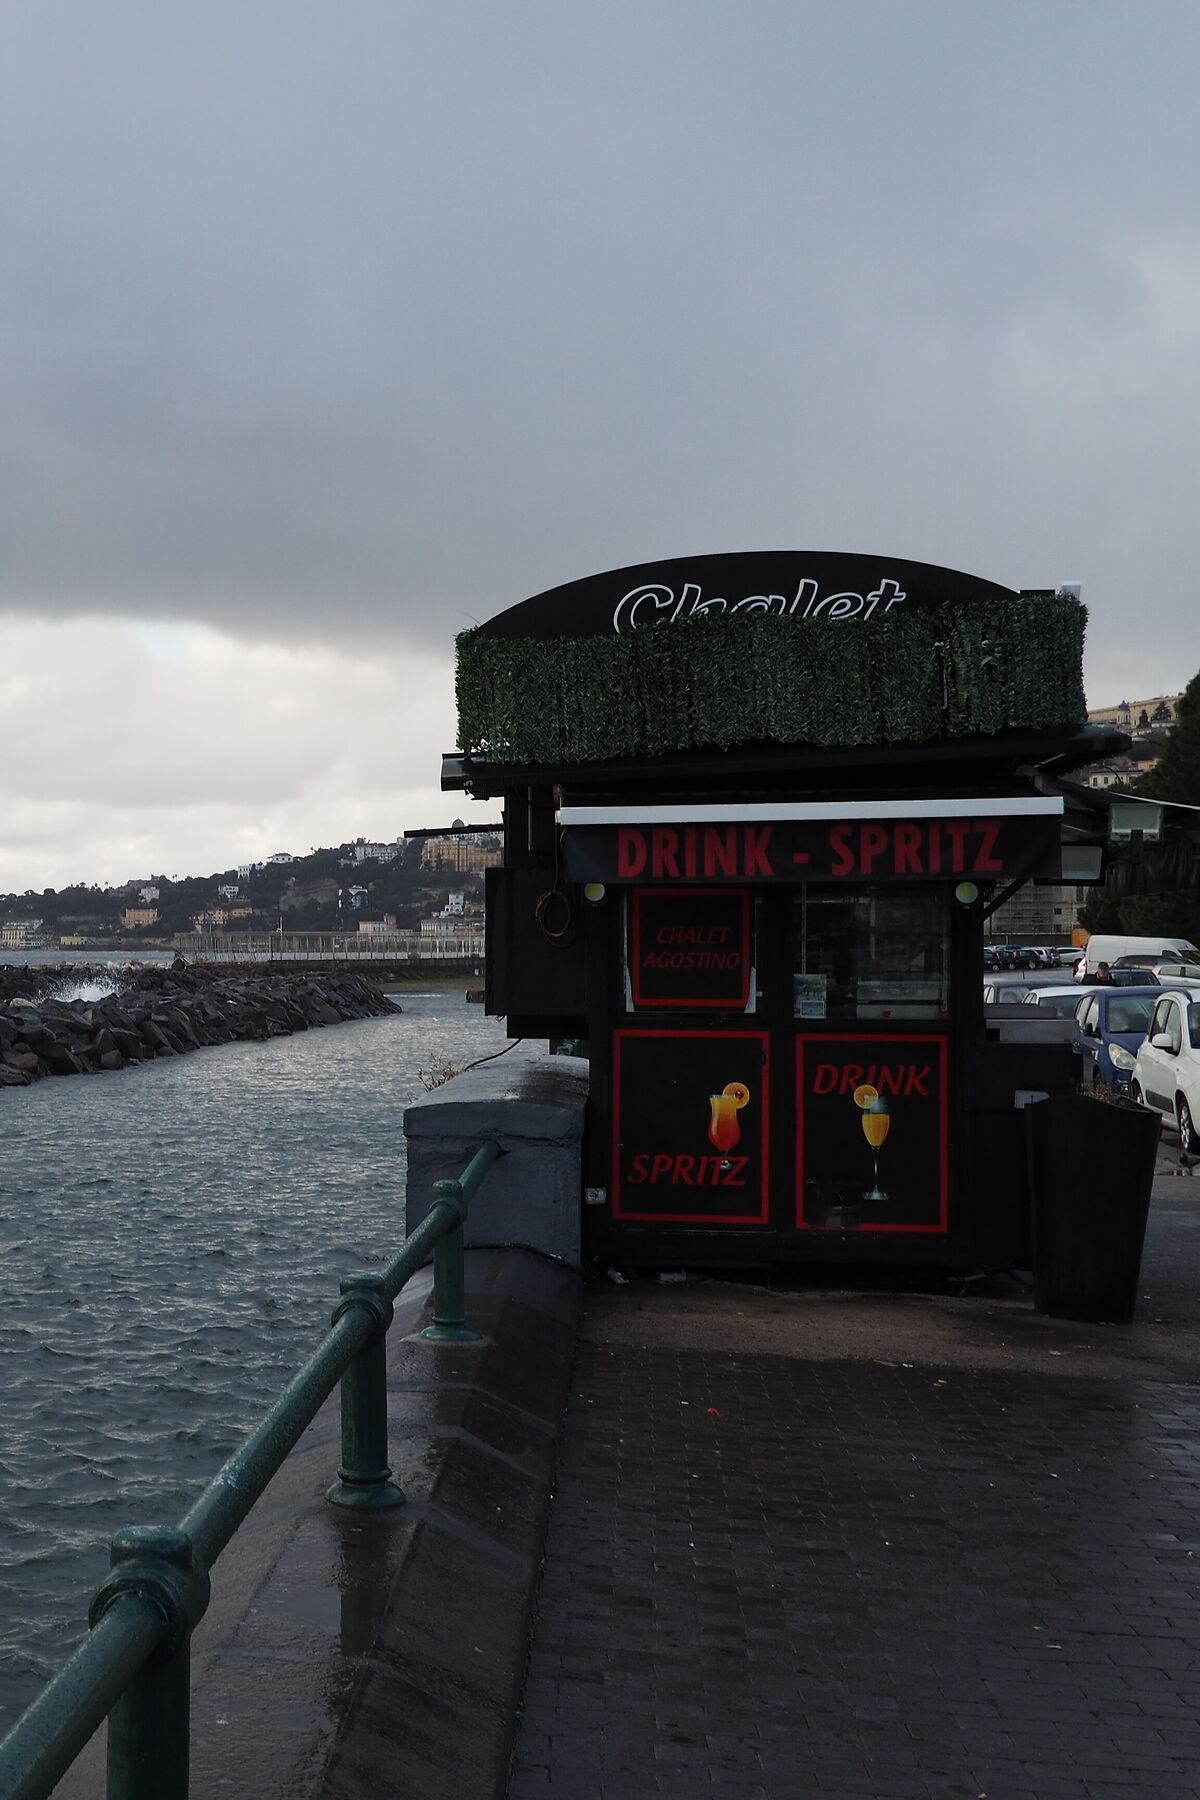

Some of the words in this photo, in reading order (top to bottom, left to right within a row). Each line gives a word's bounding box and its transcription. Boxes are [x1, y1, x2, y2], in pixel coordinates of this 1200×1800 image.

[616, 825, 776, 879] DRINK
[829, 821, 1004, 876] SPRITZ
[656, 927, 730, 944] CHALET
[642, 952, 741, 969] AGOSTINO
[812, 1064, 932, 1096] DRINK
[627, 1154, 750, 1186] SPRITZ
